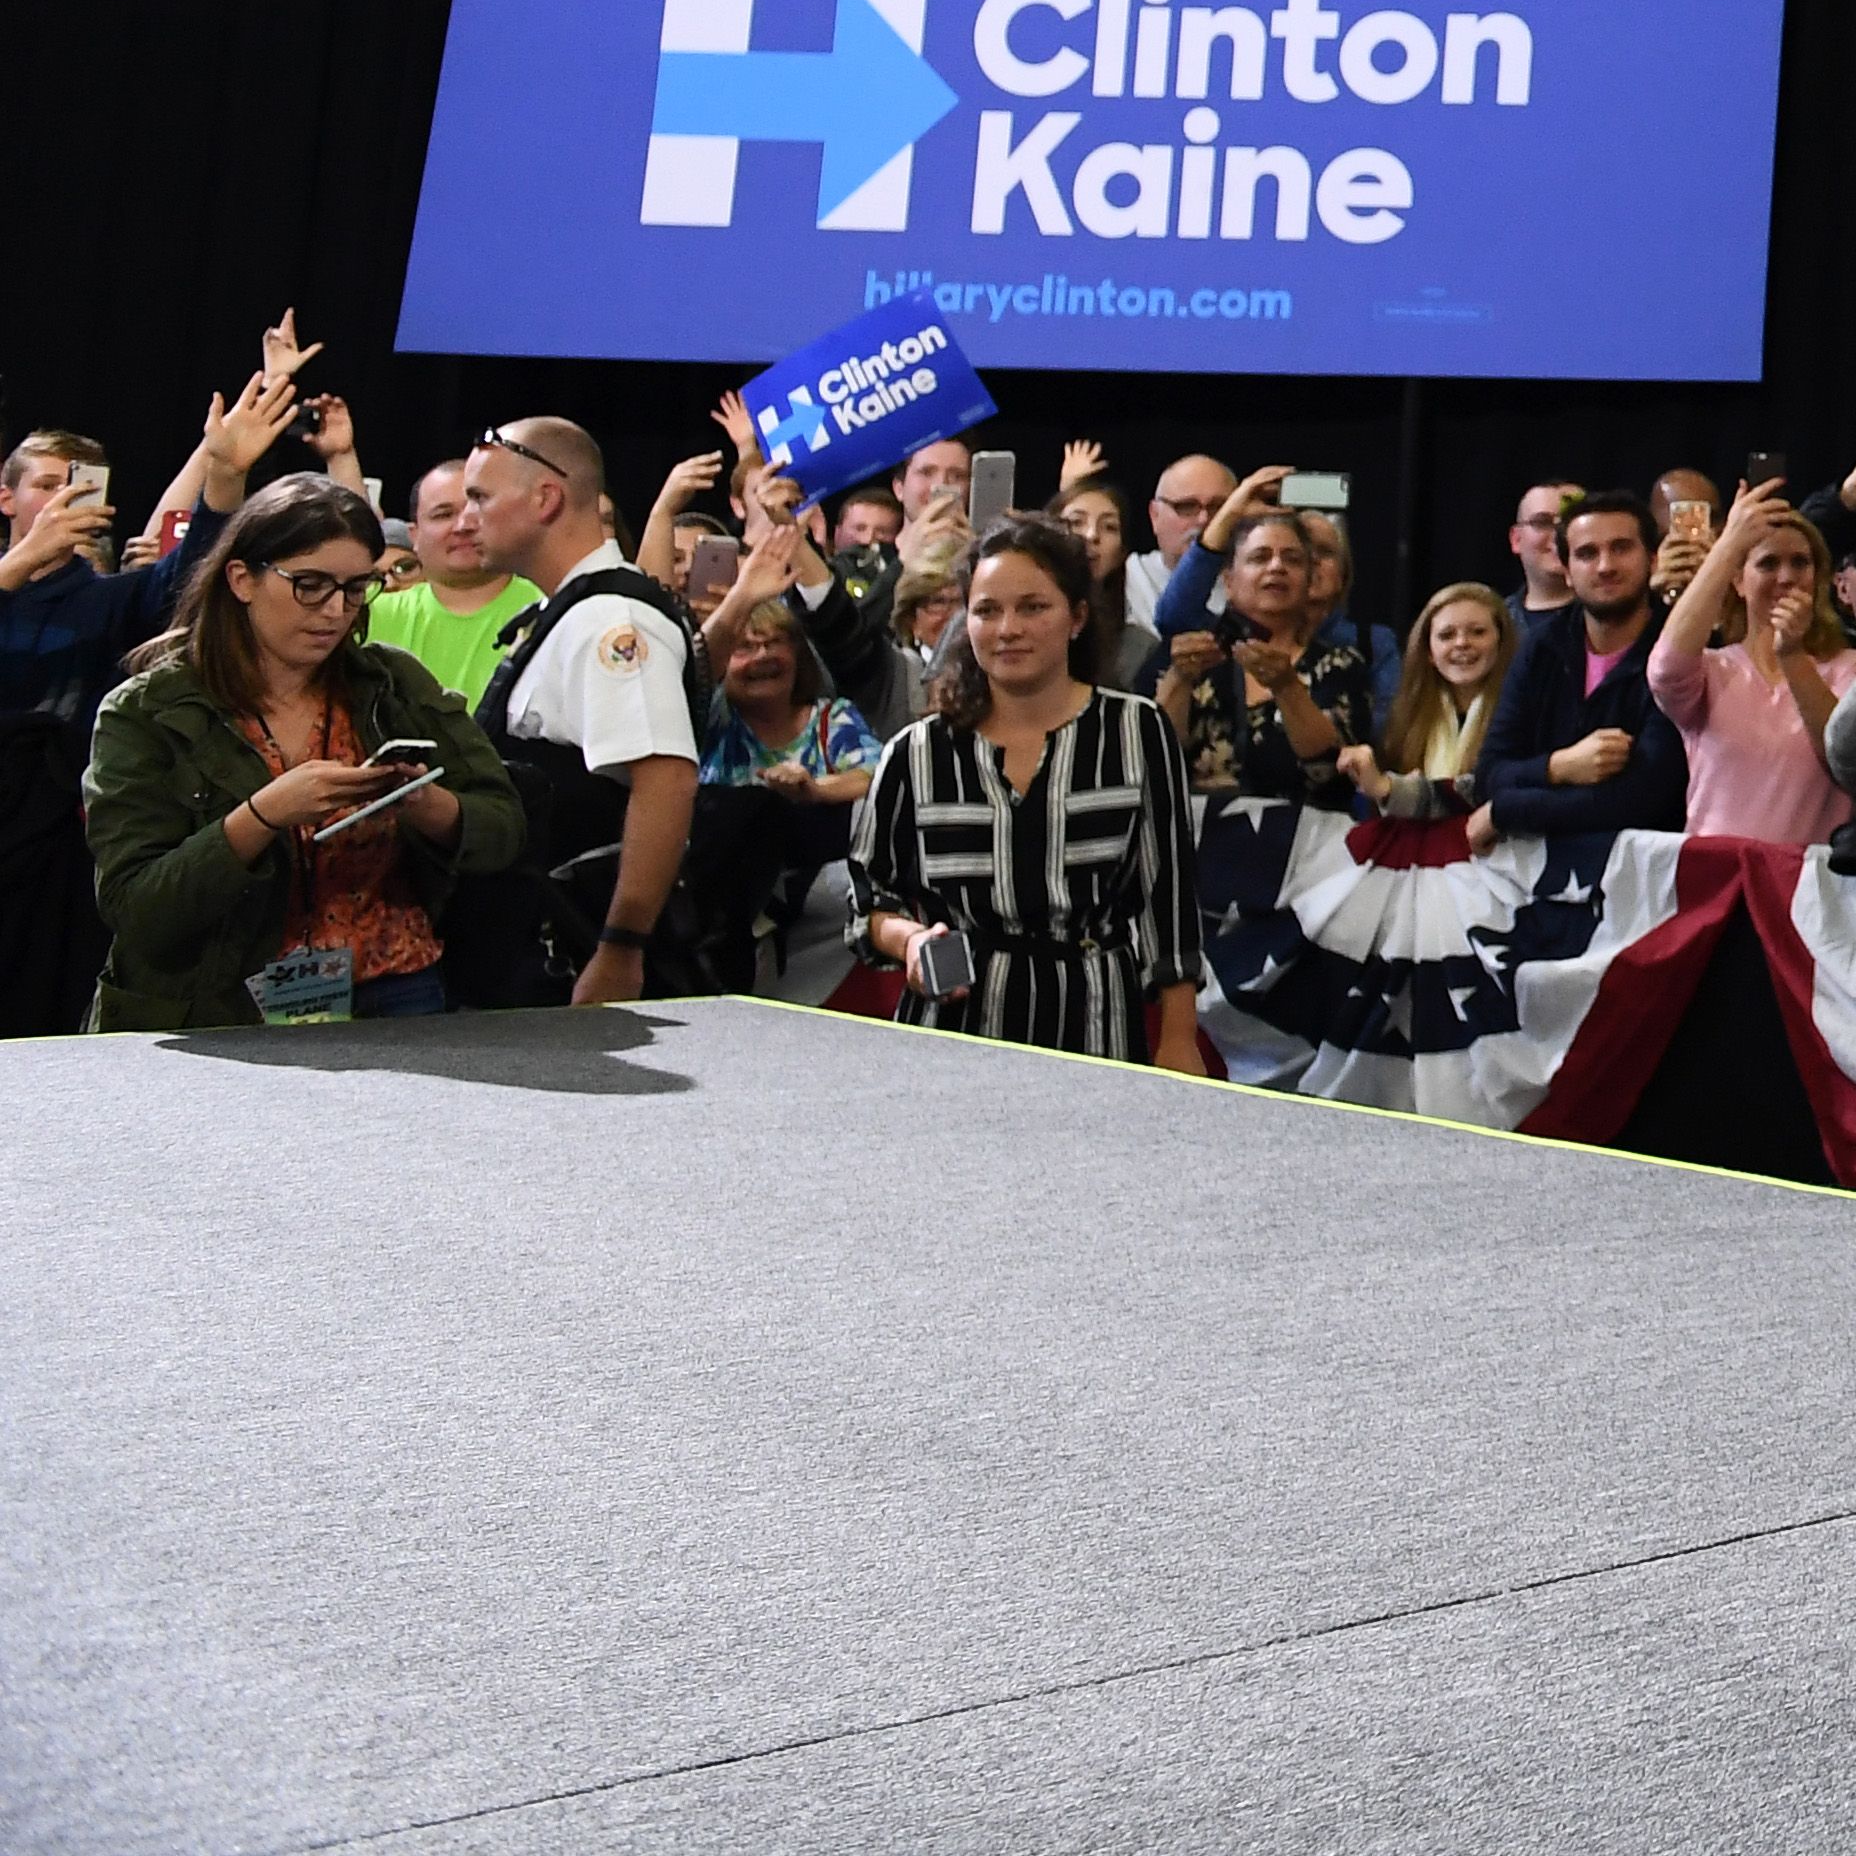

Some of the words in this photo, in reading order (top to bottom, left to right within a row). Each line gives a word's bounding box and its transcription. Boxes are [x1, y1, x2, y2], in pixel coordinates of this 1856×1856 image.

[970, 106, 1414, 245] Kaine
[818, 325, 948, 404] Clinton
[830, 368, 938, 435] Kaine
